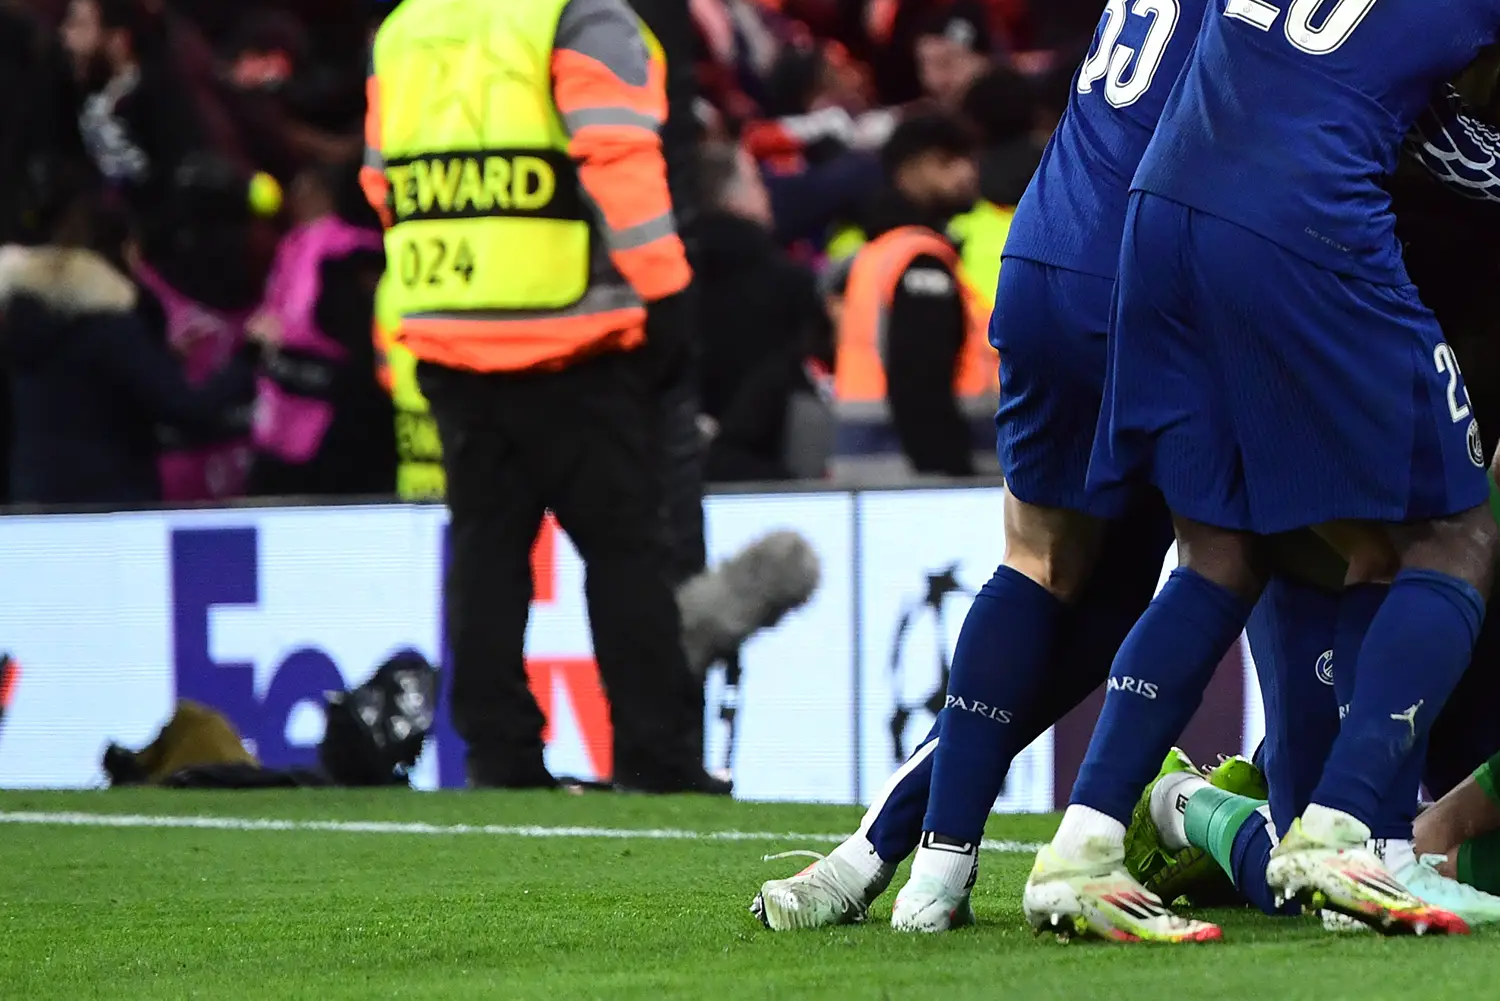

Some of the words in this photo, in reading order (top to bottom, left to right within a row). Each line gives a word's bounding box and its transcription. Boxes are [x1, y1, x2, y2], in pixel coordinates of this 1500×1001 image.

[386, 157, 556, 218] TEWARD
[1433, 342, 1472, 423] 2
[944, 694, 1013, 724] PARIS
[1107, 675, 1159, 700] ARIS
